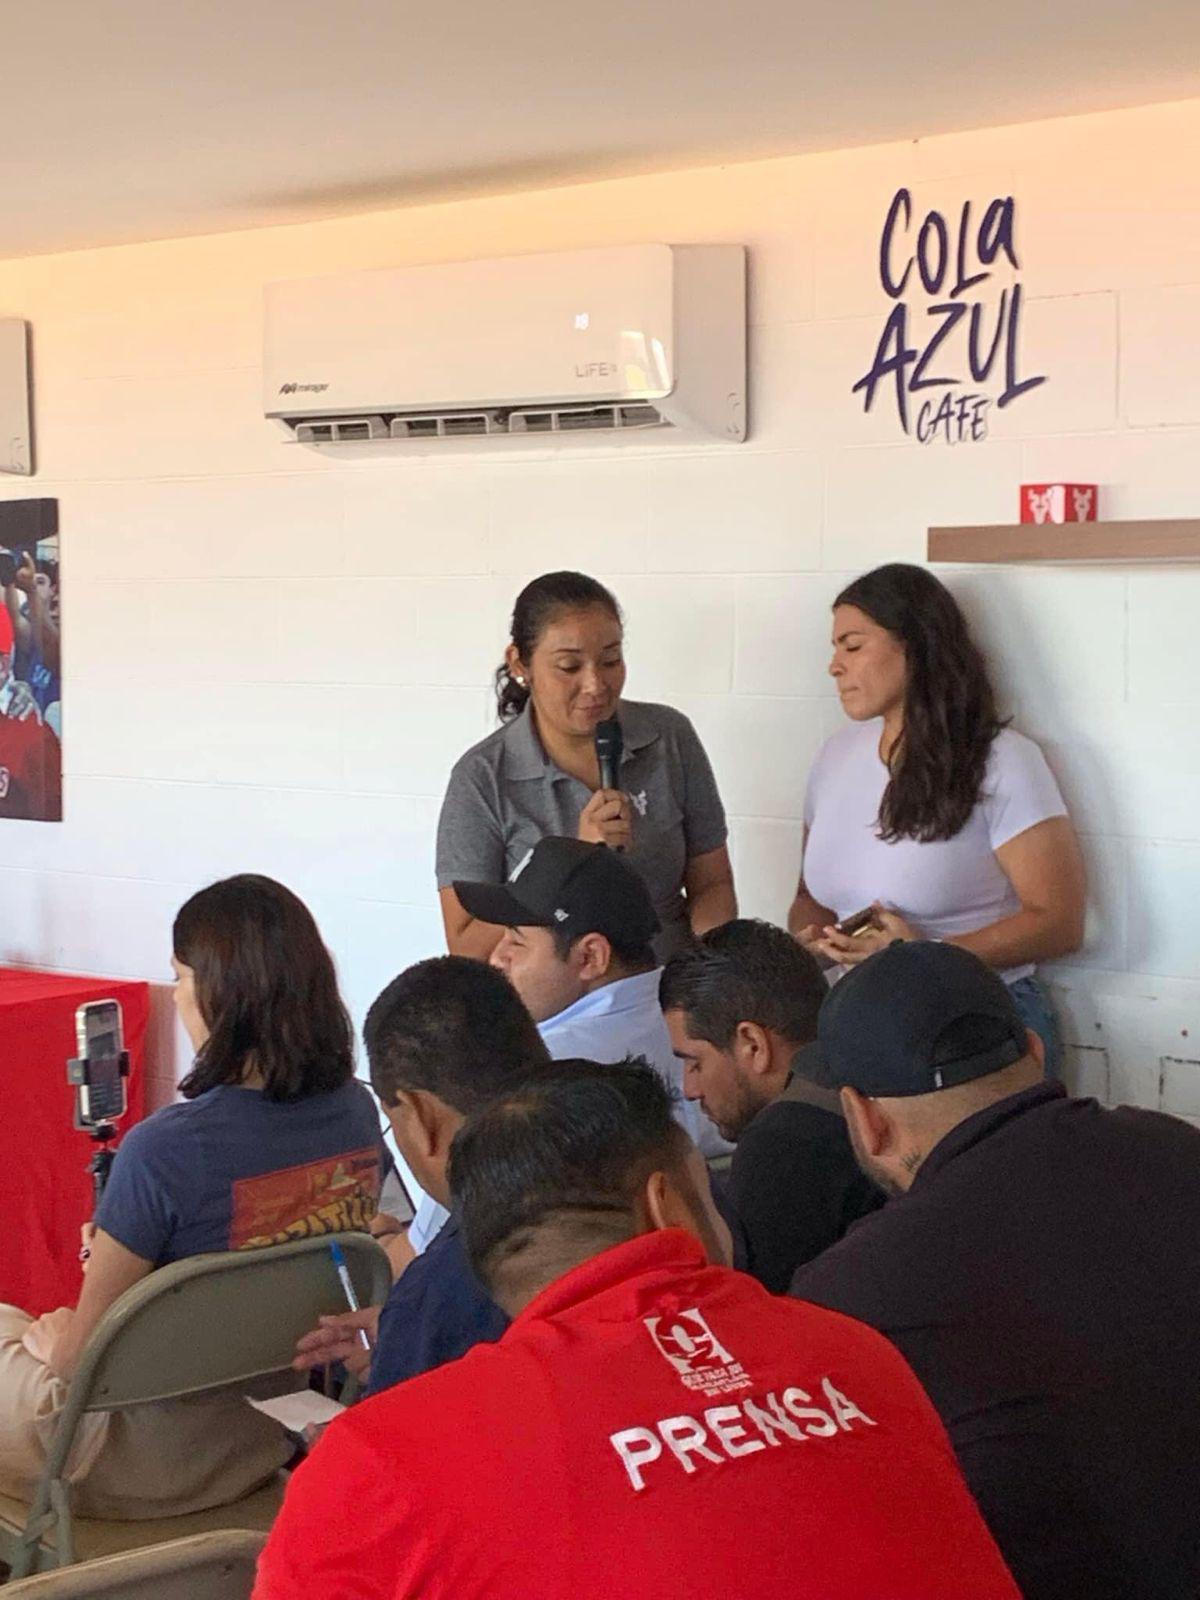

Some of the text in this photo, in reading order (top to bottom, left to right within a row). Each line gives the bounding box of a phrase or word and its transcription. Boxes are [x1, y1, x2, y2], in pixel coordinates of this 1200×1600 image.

[852, 283, 1048, 436] AZUL
[917, 392, 990, 443] CAFE
[609, 1377, 878, 1491] PRENSA
